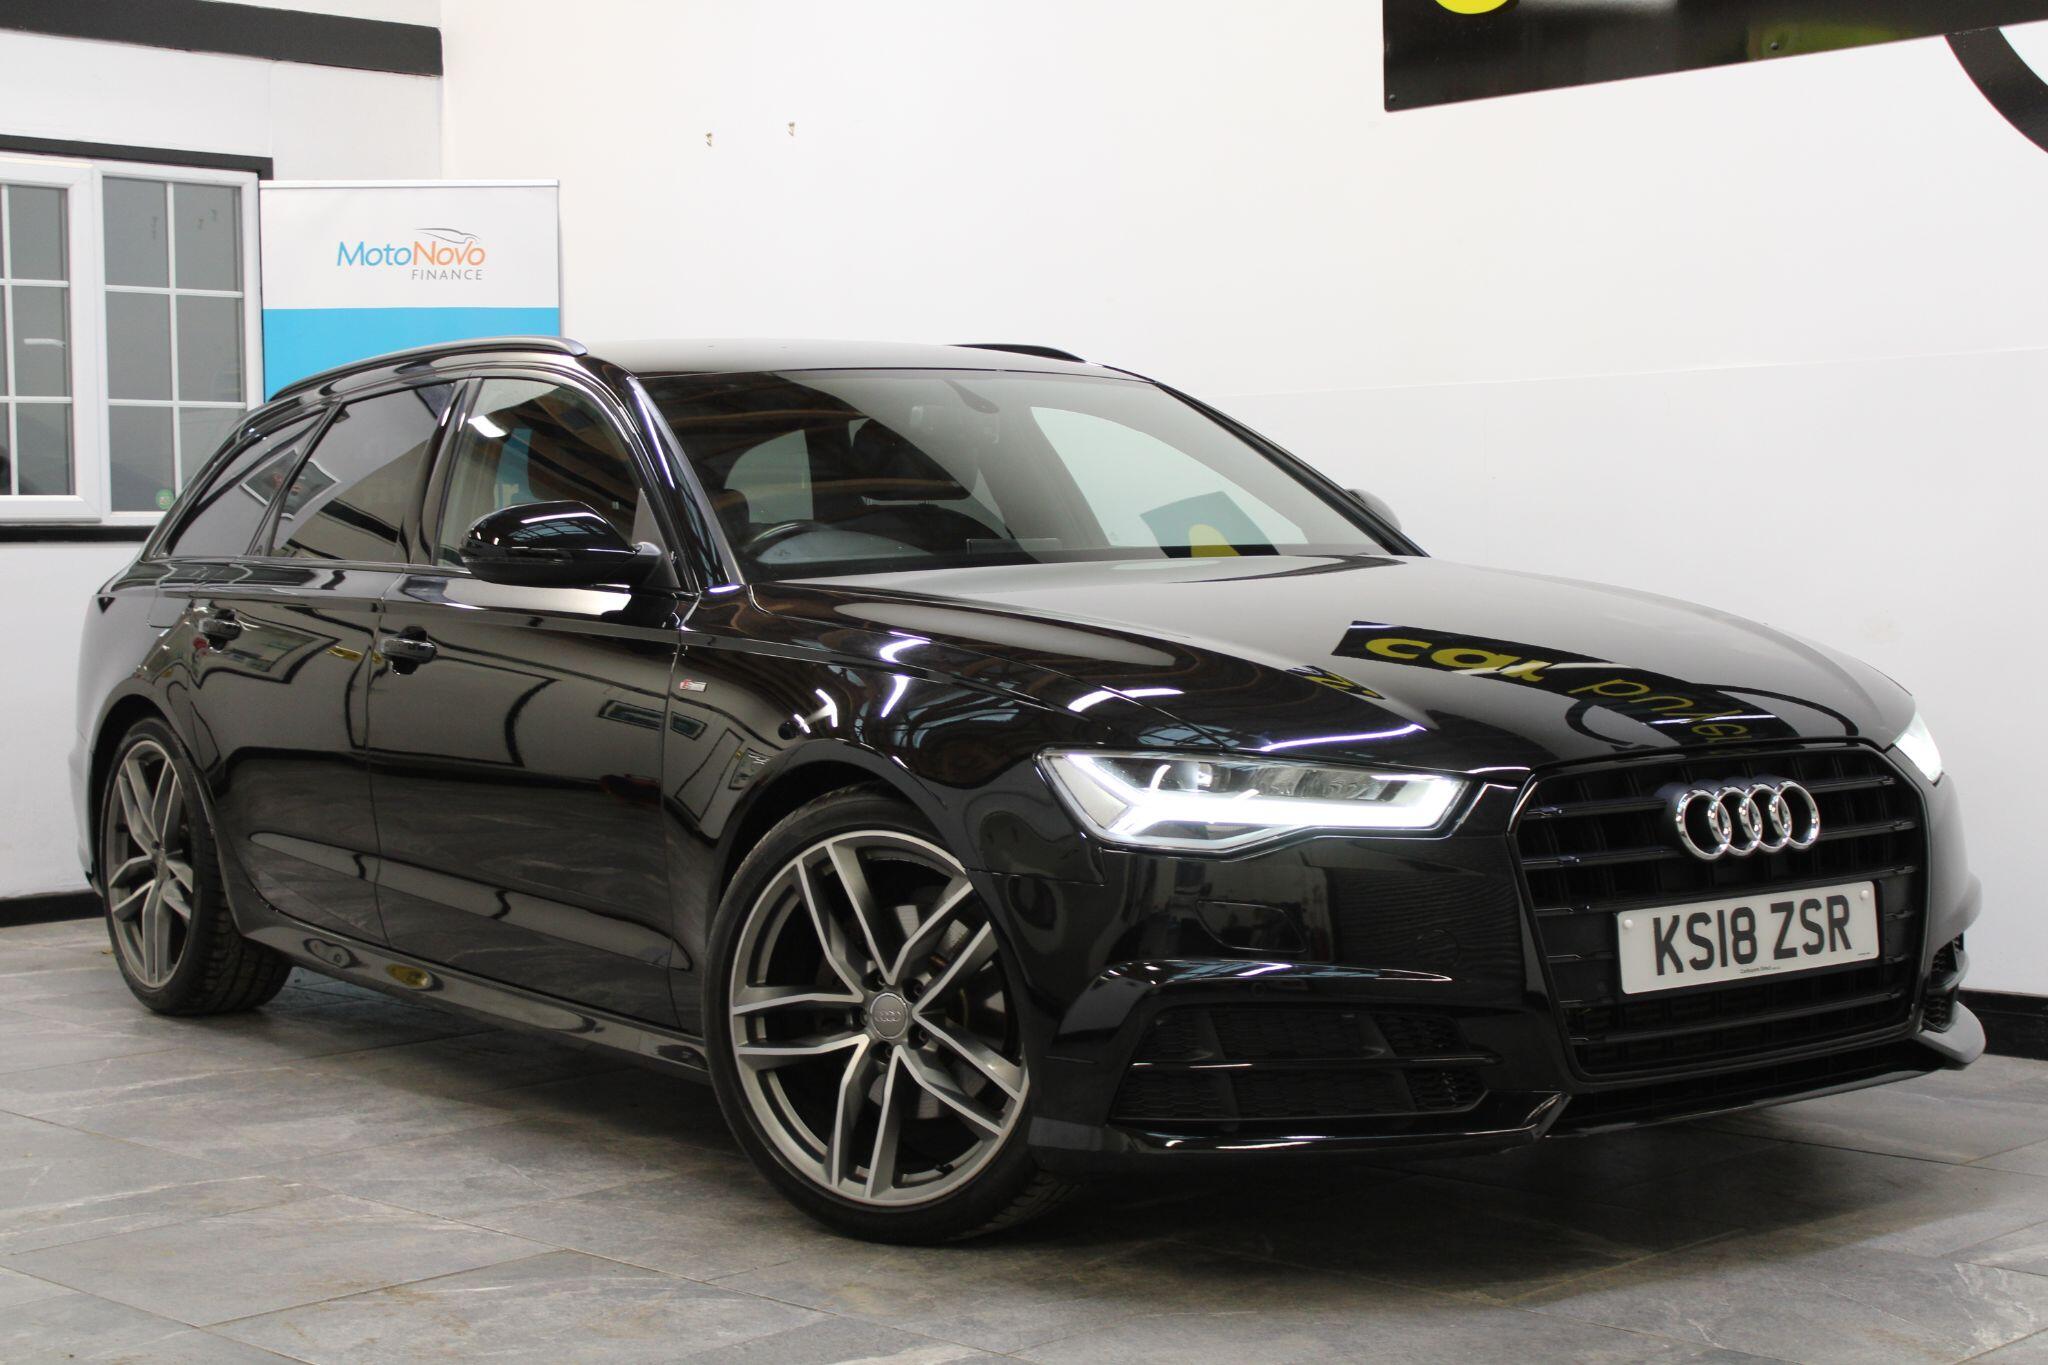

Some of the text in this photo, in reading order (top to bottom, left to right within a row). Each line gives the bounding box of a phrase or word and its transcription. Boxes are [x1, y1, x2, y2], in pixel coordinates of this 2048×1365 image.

[337, 240, 486, 266] MotoNovo
[411, 269, 483, 280] FINANCE
[1652, 894, 1853, 976] KS18 ZSR
